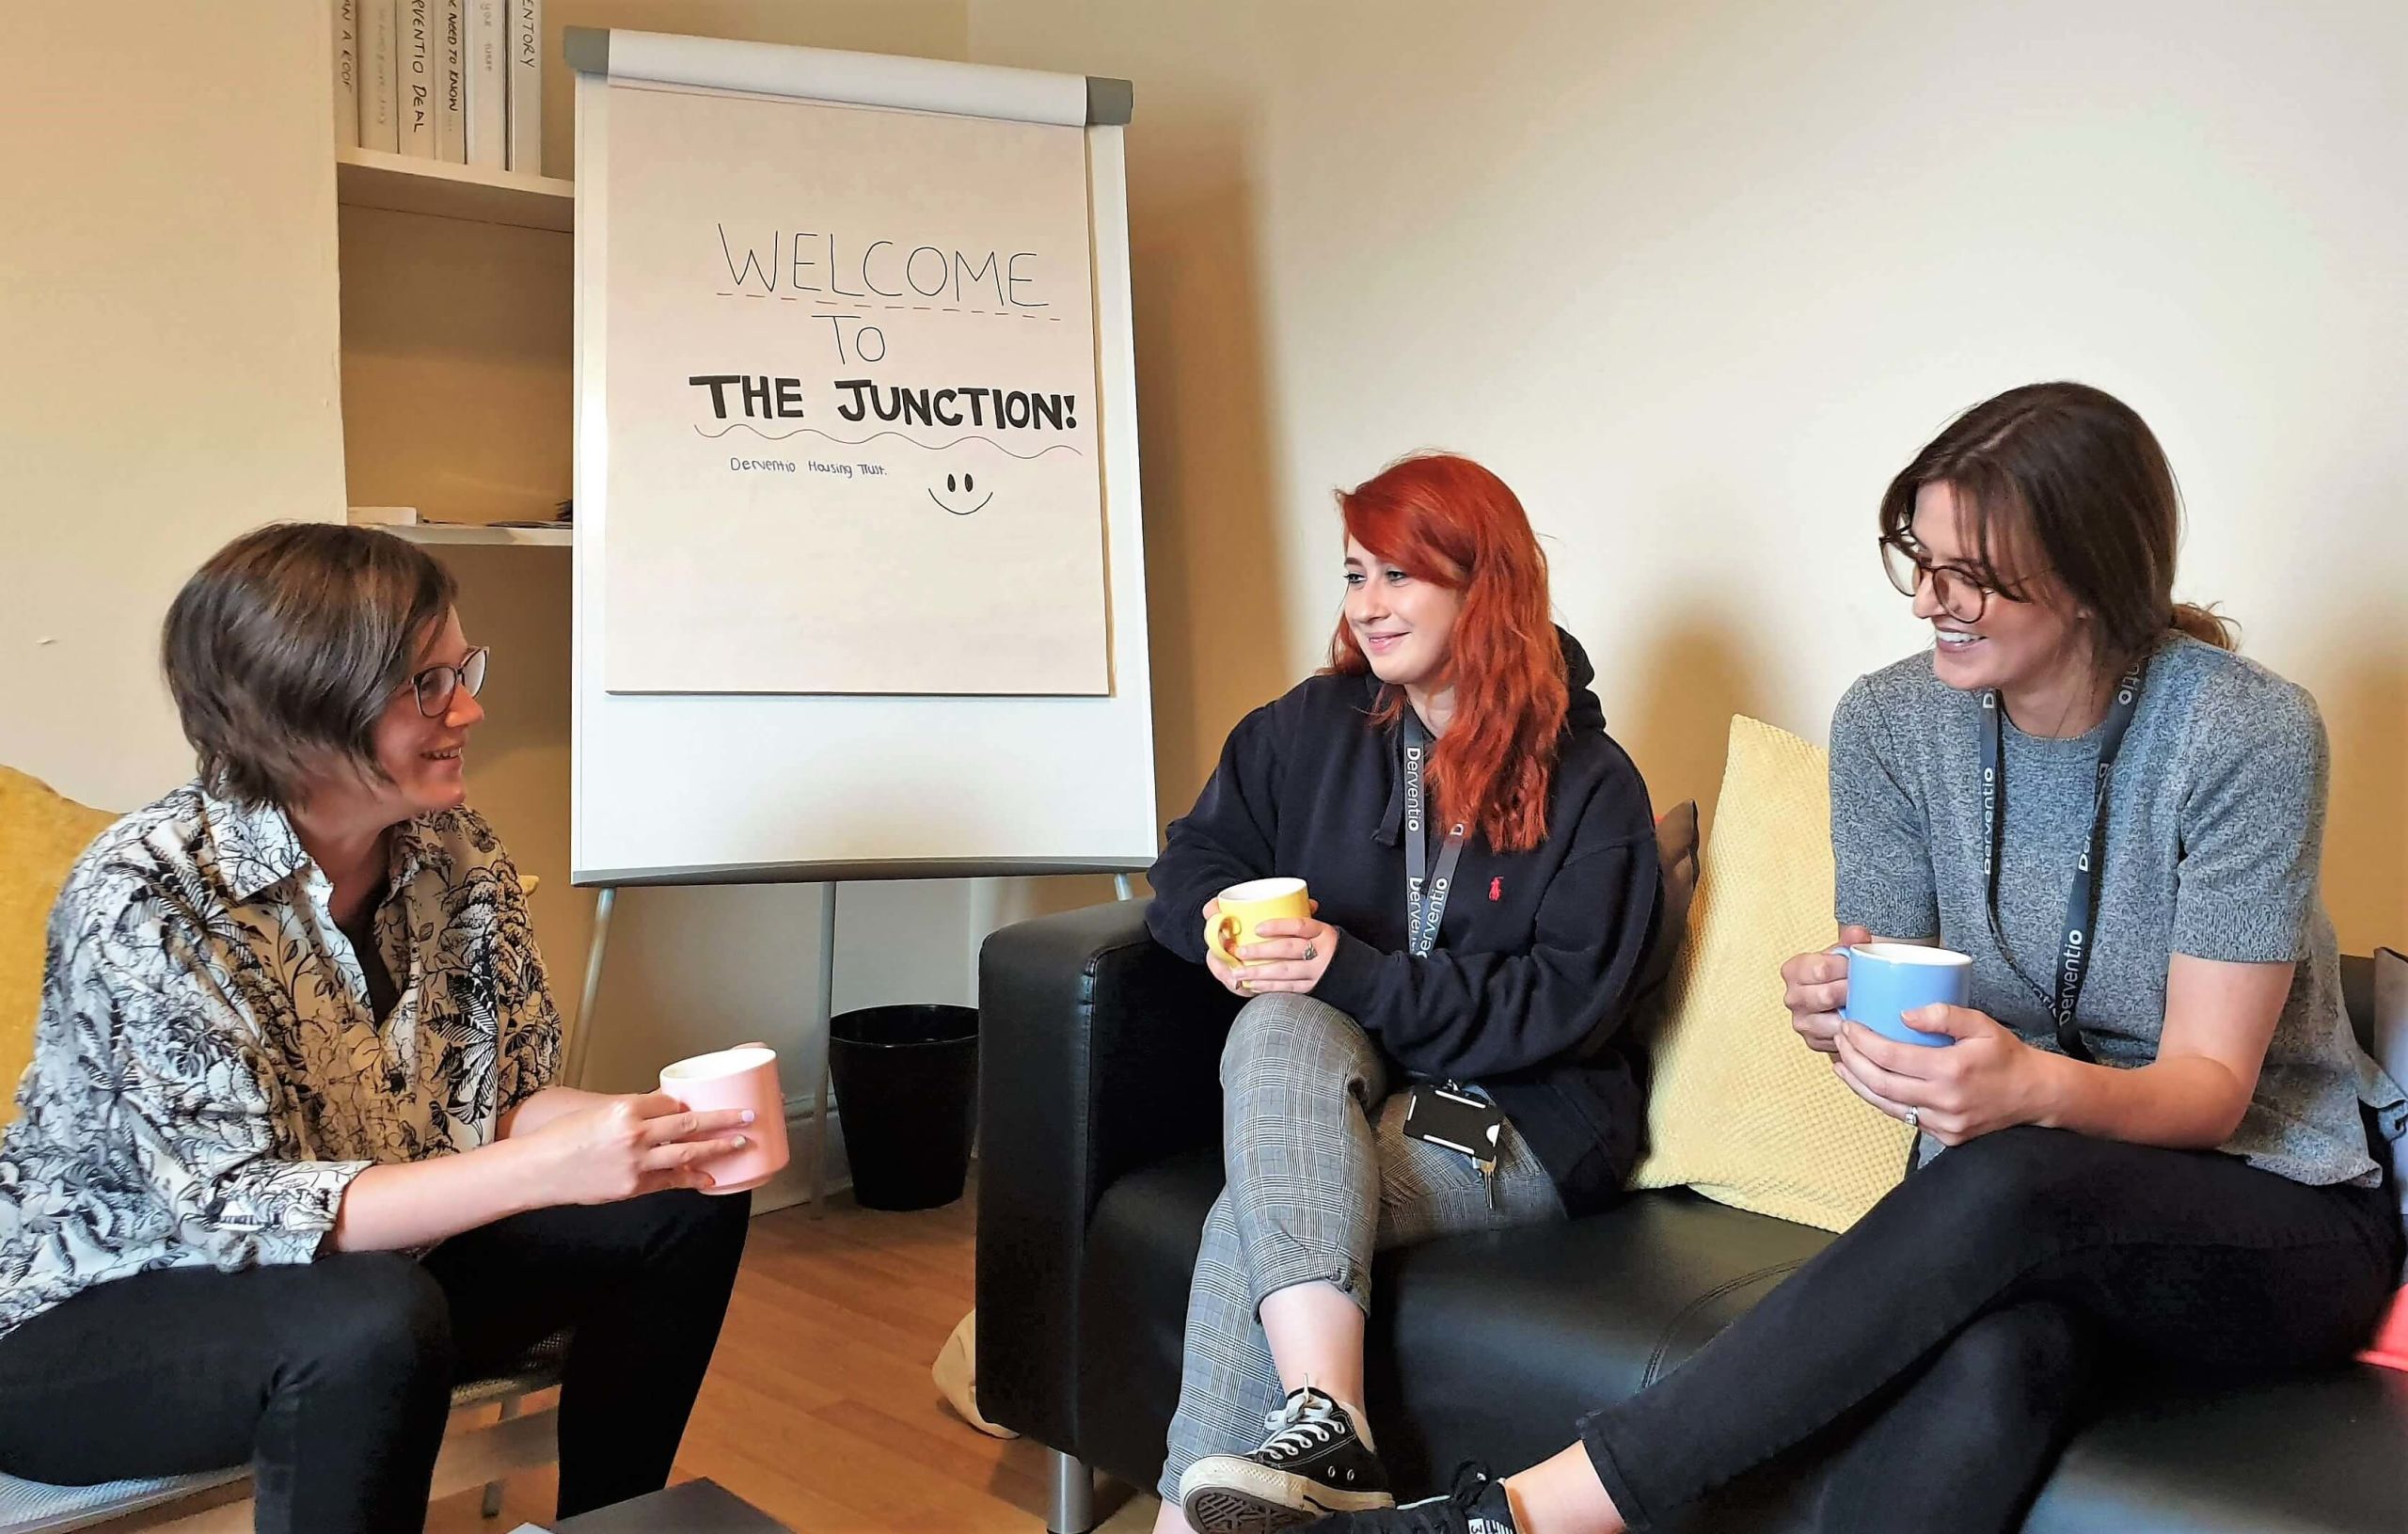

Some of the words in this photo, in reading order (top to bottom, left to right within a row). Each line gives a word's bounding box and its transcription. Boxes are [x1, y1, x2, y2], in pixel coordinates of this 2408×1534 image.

[341, 30, 352, 40] A
[447, 12, 457, 45] NEED
[447, 47, 458, 65] TO
[413, 84, 428, 133] DEAL
[719, 223, 1050, 307] WELCOME
[689, 375, 804, 419] THE
[834, 379, 1077, 431] JUNCTION!
[730, 457, 796, 472] Derventio
[808, 460, 853, 479] Housing
[1406, 747, 1421, 831] Derventio
[2058, 929, 2083, 1026] Derventio
